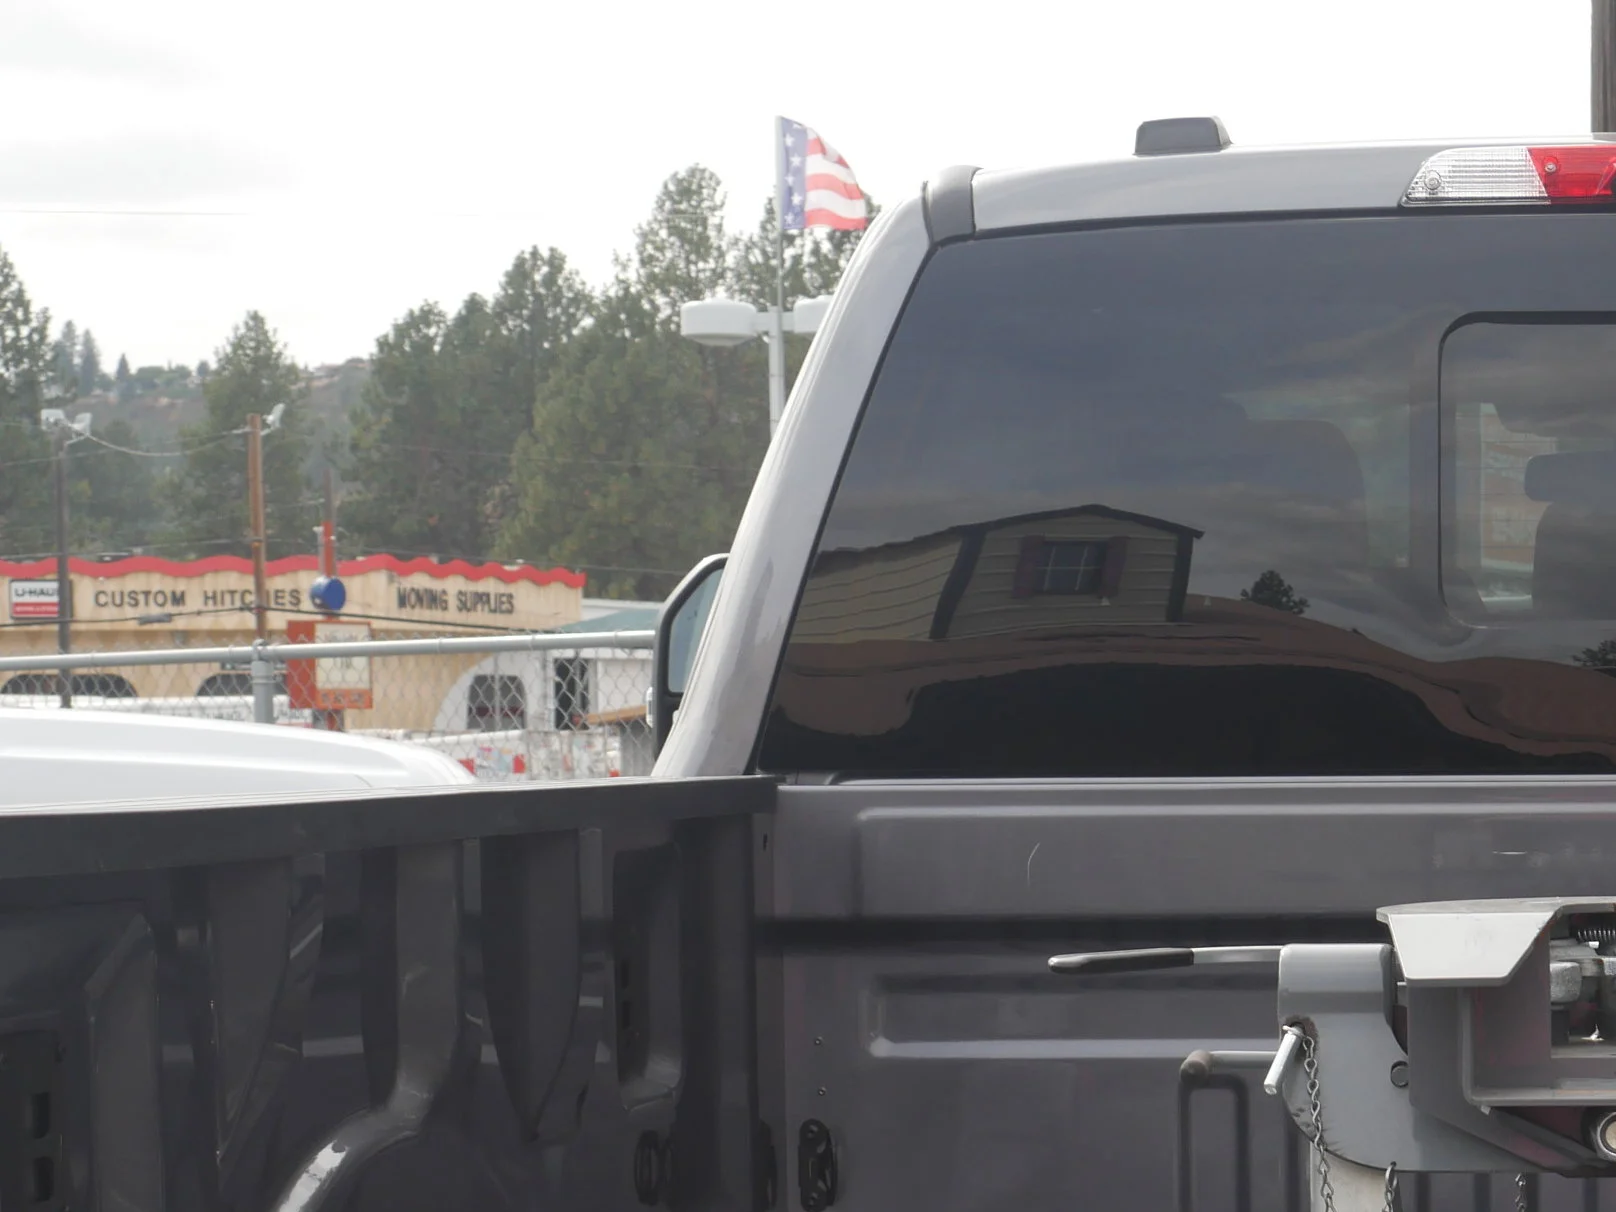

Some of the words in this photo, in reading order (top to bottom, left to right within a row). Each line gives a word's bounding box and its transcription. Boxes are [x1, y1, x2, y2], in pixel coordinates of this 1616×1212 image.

[14, 587, 59, 597] U-HAU
[94, 589, 186, 608] CUSTOM
[396, 587, 449, 612] MOVING
[455, 589, 515, 615] SUPPLIES
